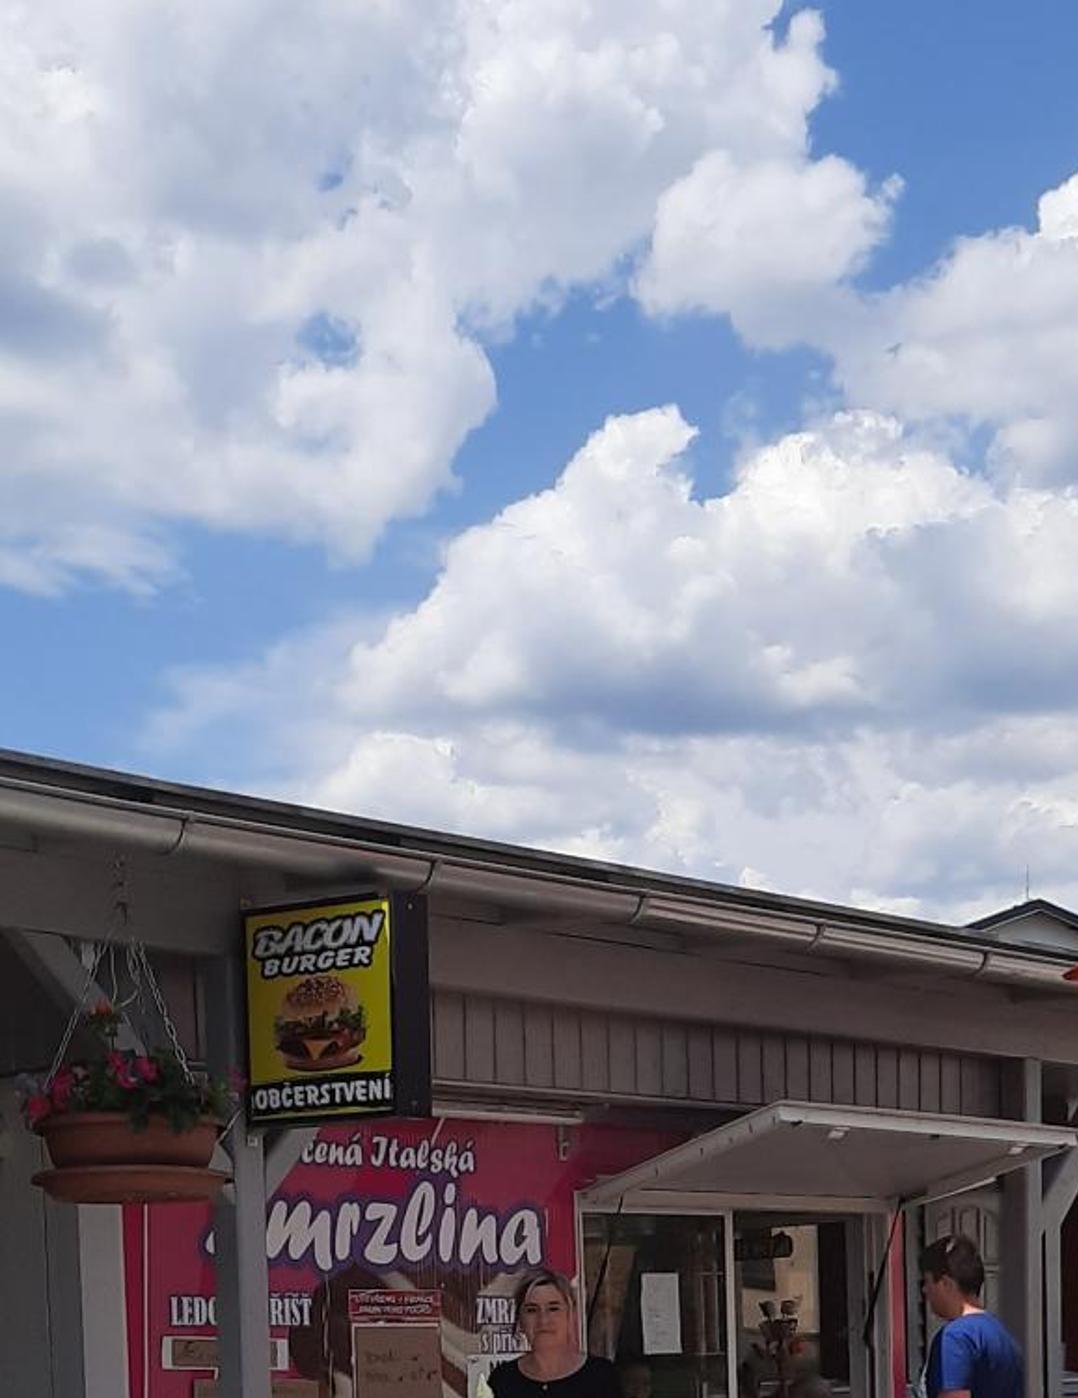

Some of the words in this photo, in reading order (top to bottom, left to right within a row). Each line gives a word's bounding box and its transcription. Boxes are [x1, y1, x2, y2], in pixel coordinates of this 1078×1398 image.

[254, 912, 384, 957] BACON
[264, 946, 371, 977] BURGER
[255, 1073, 391, 1110] OBČERSTVENÍ
[371, 1135, 475, 1178] Italská
[206, 1181, 542, 1271] mrzlina
[170, 1296, 217, 1327] LED
[269, 1292, 313, 1327] ŘÍŠŤ
